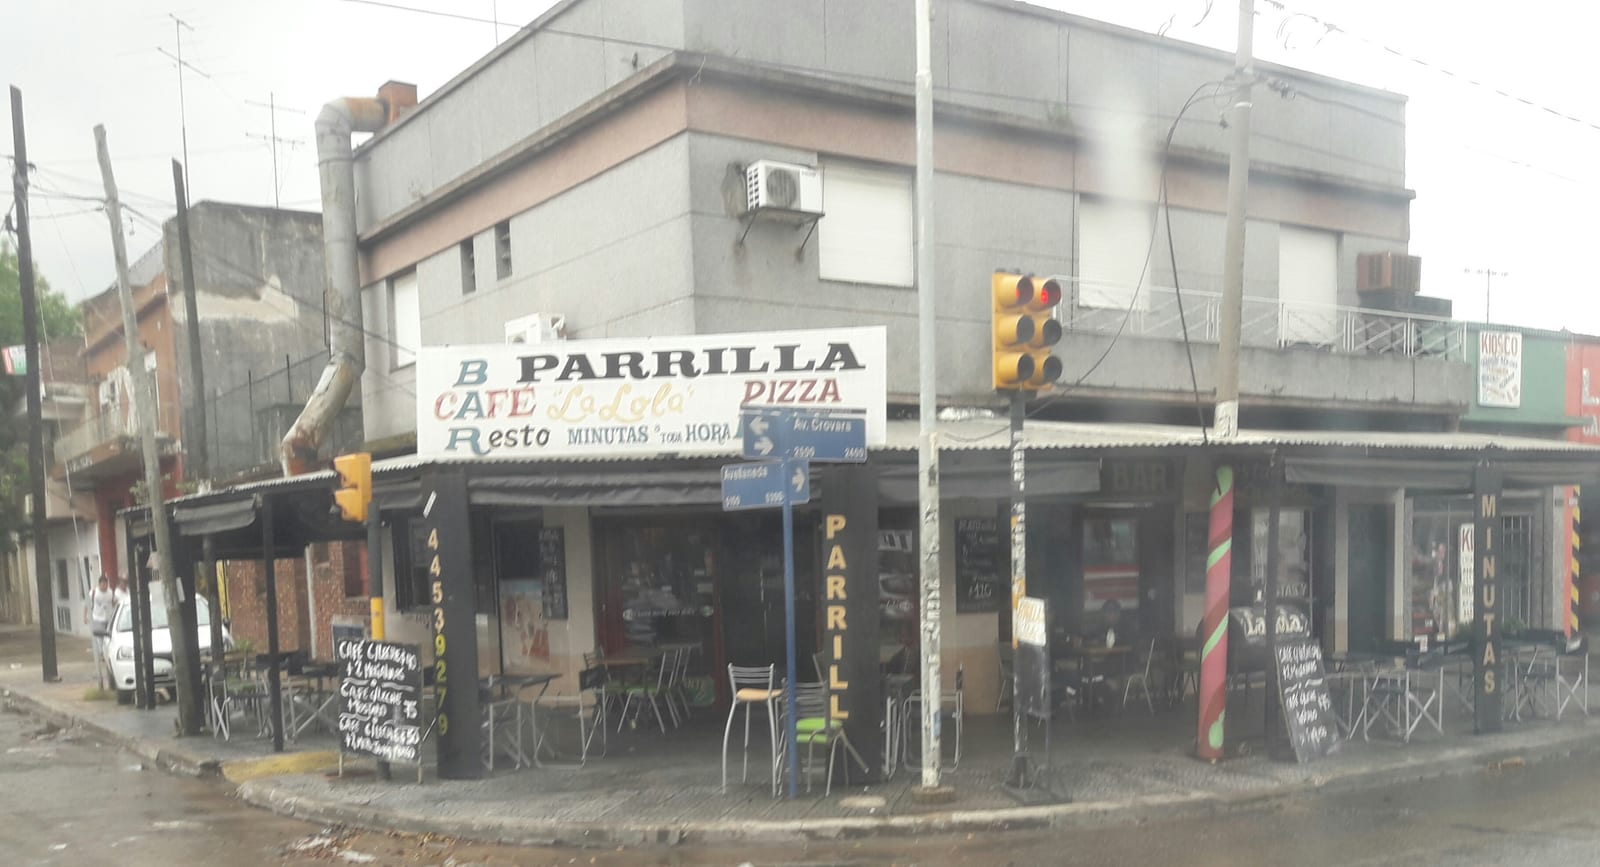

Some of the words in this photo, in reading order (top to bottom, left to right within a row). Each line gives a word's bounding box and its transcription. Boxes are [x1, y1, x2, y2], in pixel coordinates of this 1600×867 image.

[516, 343, 867, 383] PARRILLA
[1481, 333, 1519, 356] KIOSCO
[434, 383, 536, 421] CAFÉ
[740, 378, 842, 409] PIZZA
[445, 424, 551, 456] Resto
[568, 425, 649, 445] MINUTAS
[686, 423, 730, 445] HORA
[793, 419, 809, 431] Av.
[811, 419, 851, 432] Crovara
[1482, 495, 1496, 694] MINUTAS
[826, 514, 849, 722] PARRILL
